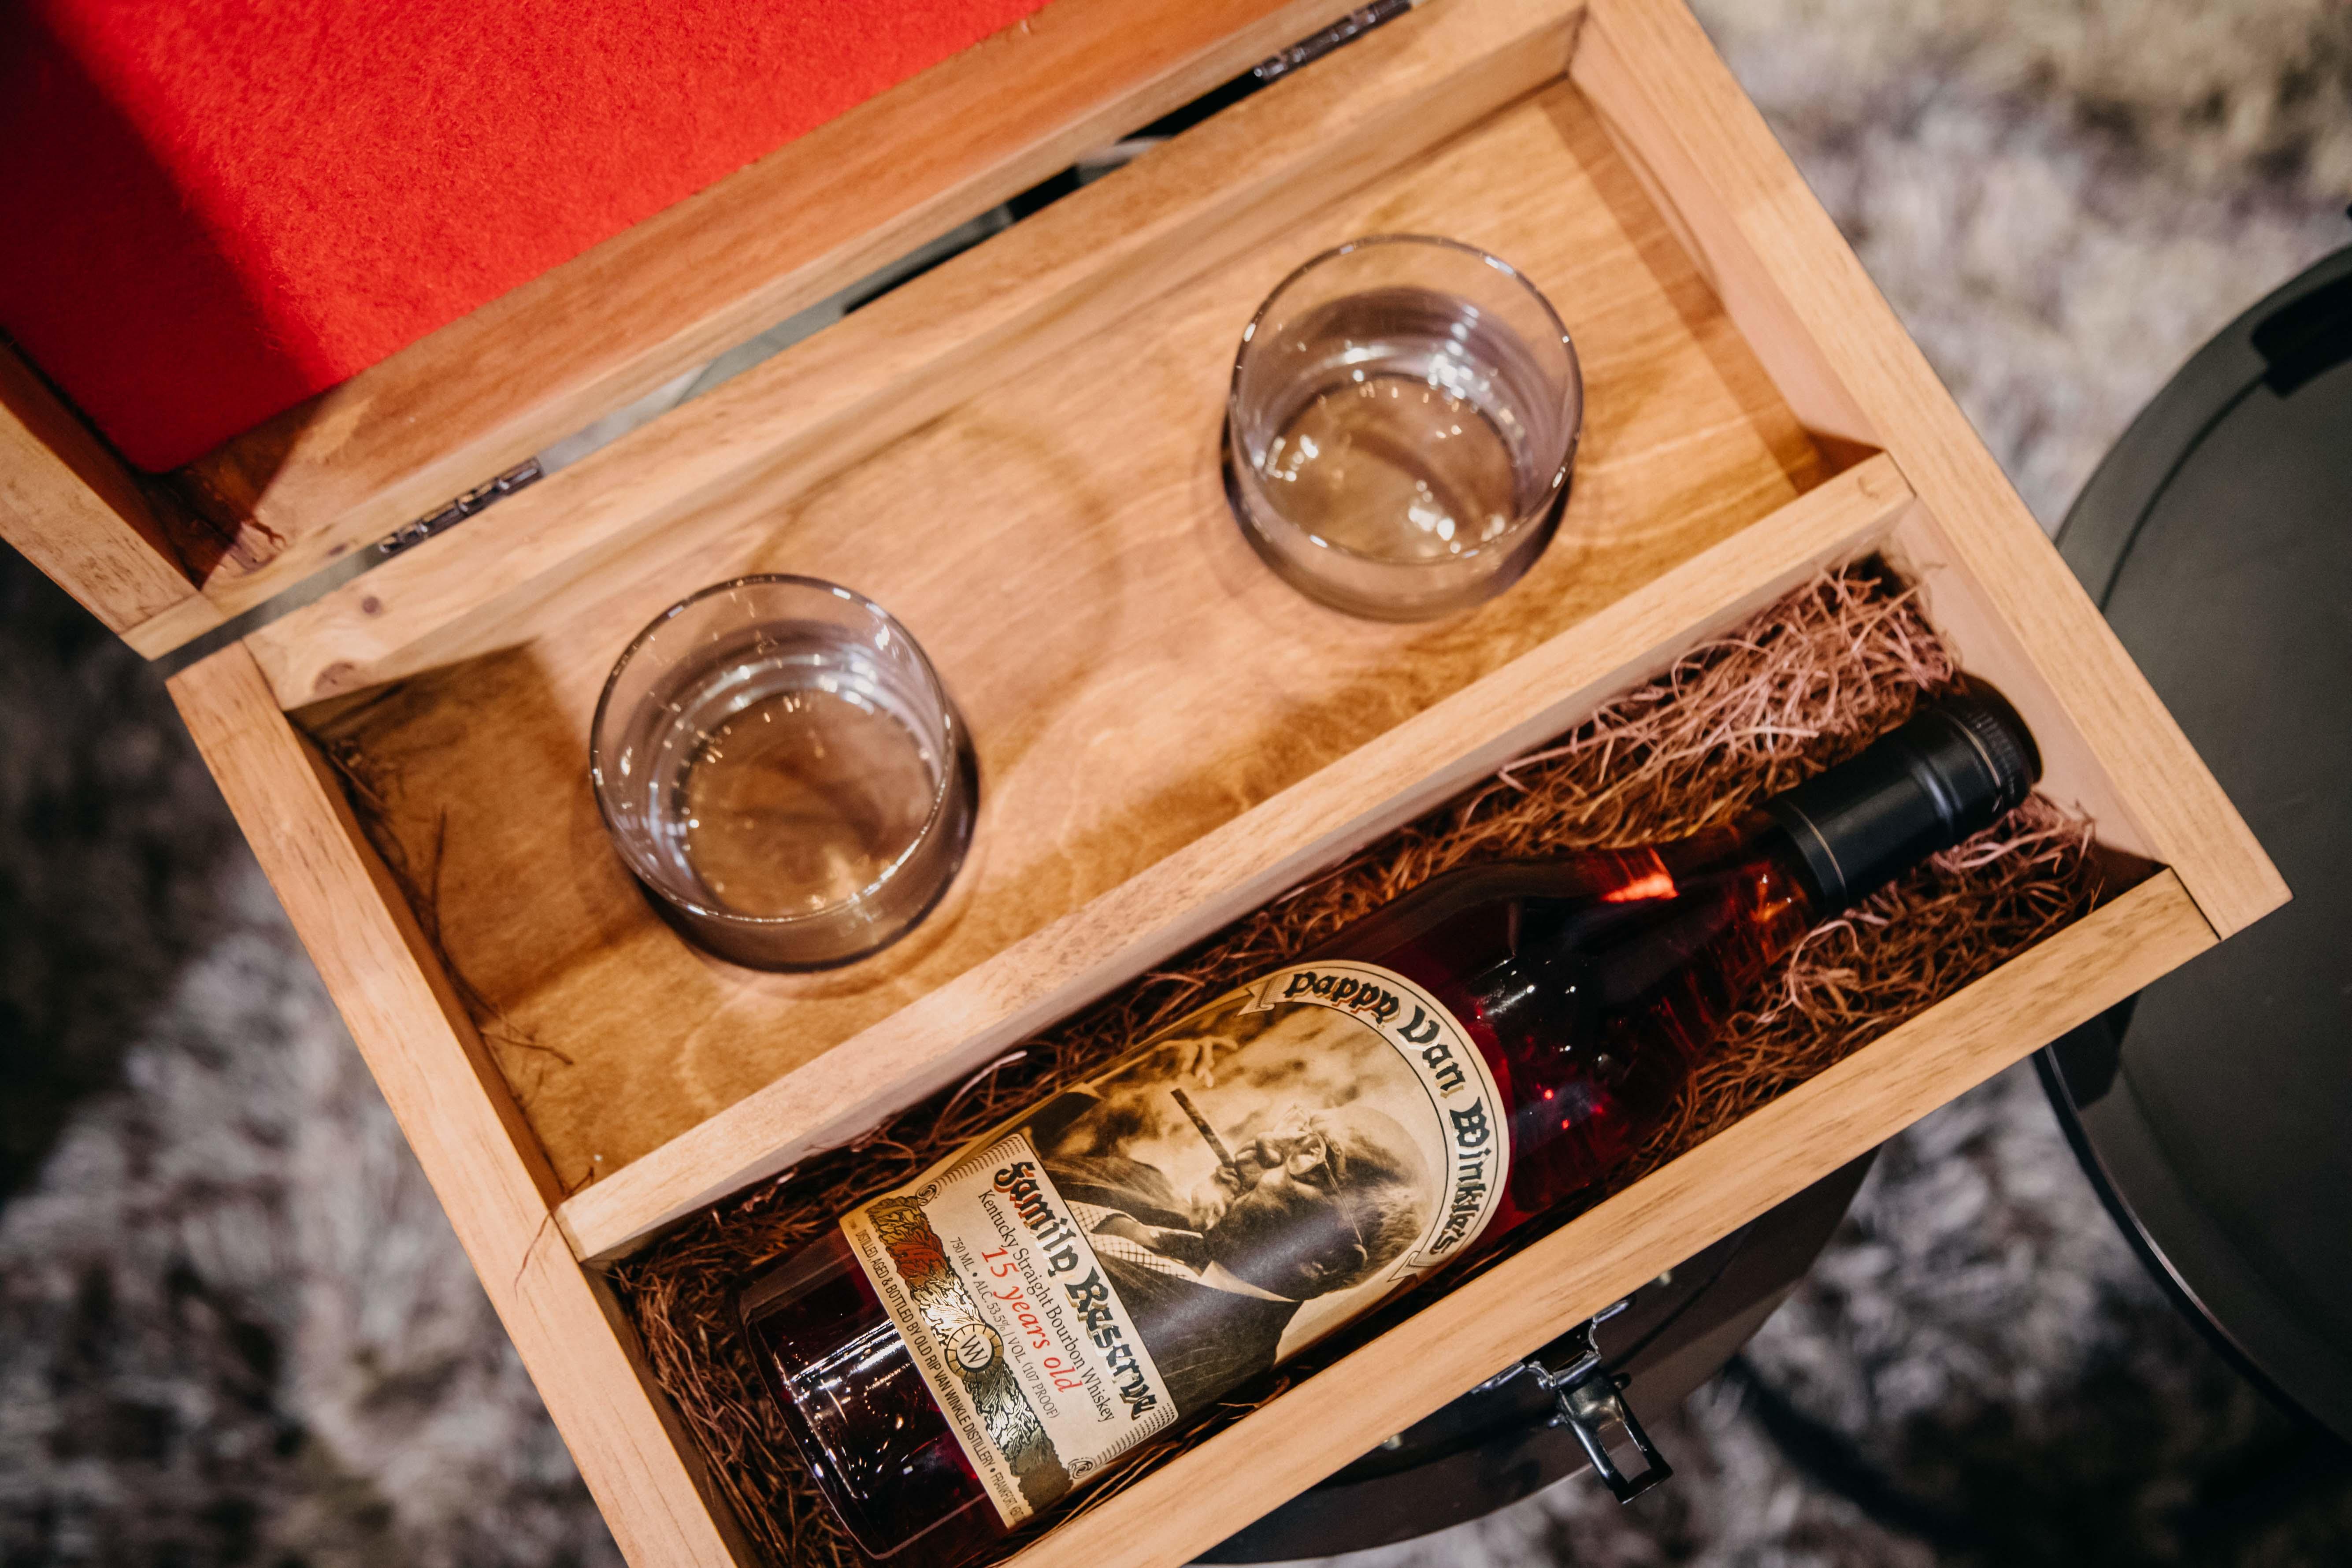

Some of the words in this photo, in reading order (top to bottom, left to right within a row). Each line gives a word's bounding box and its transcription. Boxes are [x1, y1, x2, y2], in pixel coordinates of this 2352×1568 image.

[1284, 971, 1400, 1027] Pappy
[1397, 1005, 1466, 1099] Van
[856, 1229, 878, 1261] DISTILLED,
[982, 1248, 1019, 1277] 15
[871, 1258, 889, 1279] AGED
[882, 1277, 893, 1287] &
[886, 1284, 913, 1323] BOTTLED
[978, 1189, 1018, 1247] Kentucky
[1013, 1248, 1053, 1308] Straight
[1046, 1305, 1085, 1369] Bourbon
[1080, 1367, 1114, 1422] Whiskey
[994, 1161, 1079, 1278] Family
[1065, 1266, 1157, 1420] Reserve
[906, 1322, 922, 1335] BY
[950, 1237, 965, 1253] 750
[959, 1253, 974, 1271] ML.
[973, 1281, 994, 1303] ALC.
[987, 1302, 1010, 1335] 53.5%
[1008, 1337, 1026, 1363] VOL.
[1022, 1362, 1039, 1381] (107
[1032, 1383, 1060, 1418] PROOF)
[994, 1287, 1050, 1348] years
[914, 1336, 932, 1356] OLD
[925, 1355, 941, 1370] RIP
[934, 1370, 952, 1391] VAN
[1044, 1357, 1082, 1393] old
[945, 1389, 970, 1425] WINKLE
[962, 1423, 995, 1467] DISTILLERY
